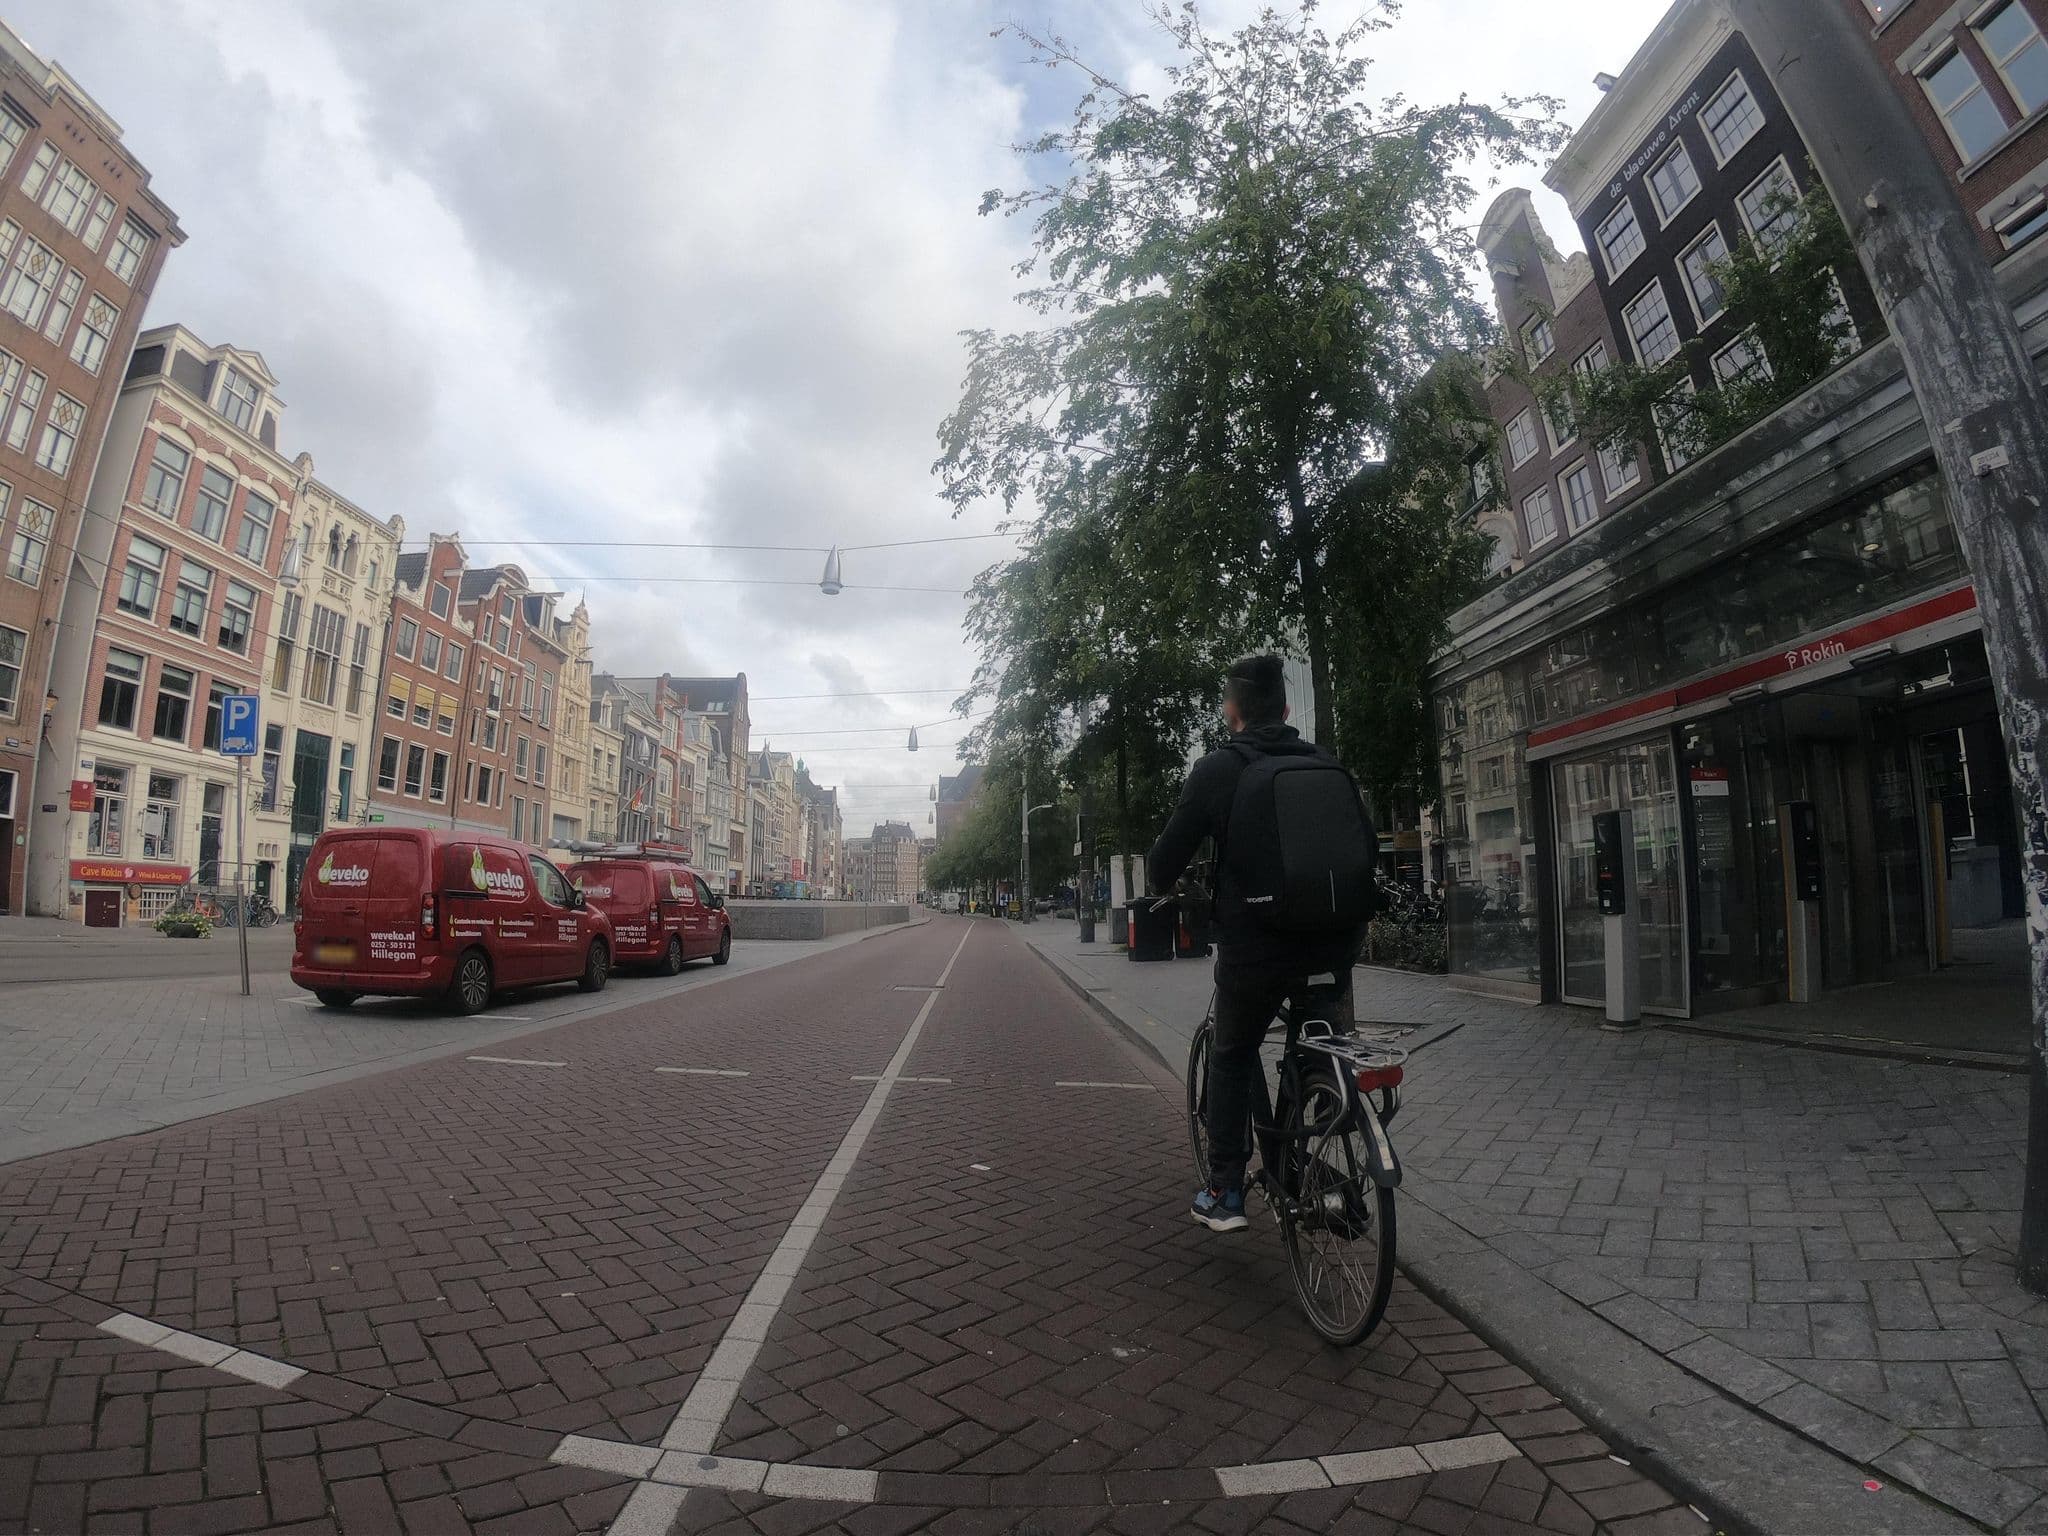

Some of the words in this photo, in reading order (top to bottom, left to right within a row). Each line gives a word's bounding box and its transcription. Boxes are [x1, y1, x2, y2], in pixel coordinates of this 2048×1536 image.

[1610, 182, 1622, 198] de
[1623, 131, 1666, 181] blaeuwe
[1668, 91, 1700, 130] Arent
[1801, 640, 1845, 666] Rokin
[229, 699, 250, 730] P
[80, 866, 100, 877] Cave
[101, 867, 123, 878] Rokin
[318, 864, 369, 884] Weveko
[470, 867, 524, 890] Weveko
[370, 930, 415, 941] weveko.nl
[371, 949, 416, 961] Hillegom
